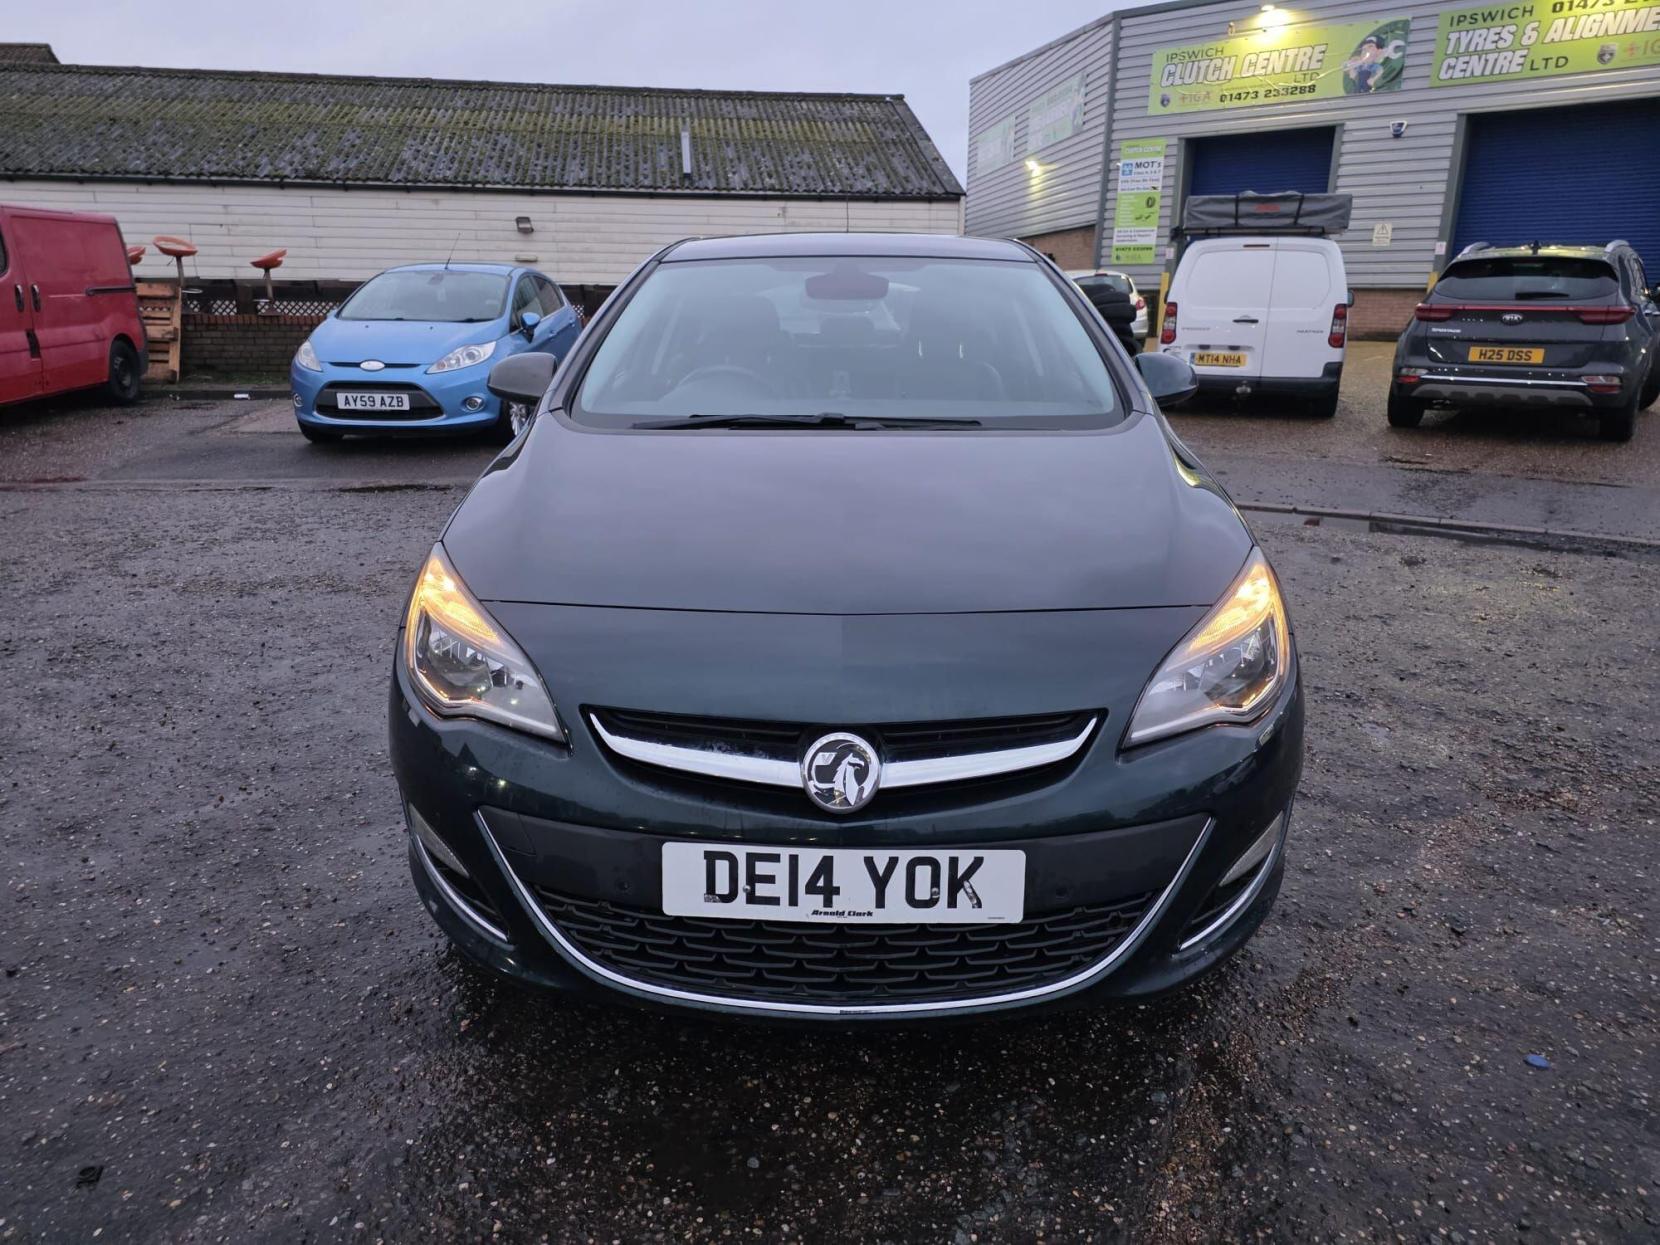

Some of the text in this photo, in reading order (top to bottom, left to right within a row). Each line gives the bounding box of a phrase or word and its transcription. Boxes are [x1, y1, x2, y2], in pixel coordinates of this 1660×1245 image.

[1450, 5, 1534, 27] IPSWICH
[1445, 6, 1660, 55] TYRES & ALIGNME
[1166, 46, 1225, 63] IPSWICH
[1160, 44, 1328, 88] CLUTCH CENTRE
[1438, 48, 1569, 80] CENTRE LTD
[1293, 71, 1321, 84] LTD
[1220, 84, 1317, 103] 01473 233288
[1197, 353, 1241, 364] MT14 NHA
[1479, 349, 1532, 361] H25 DSS
[344, 395, 404, 408] AY59 AZB
[704, 850, 984, 909] DE14 YOK
[811, 909, 873, 918] Arnold Clark
